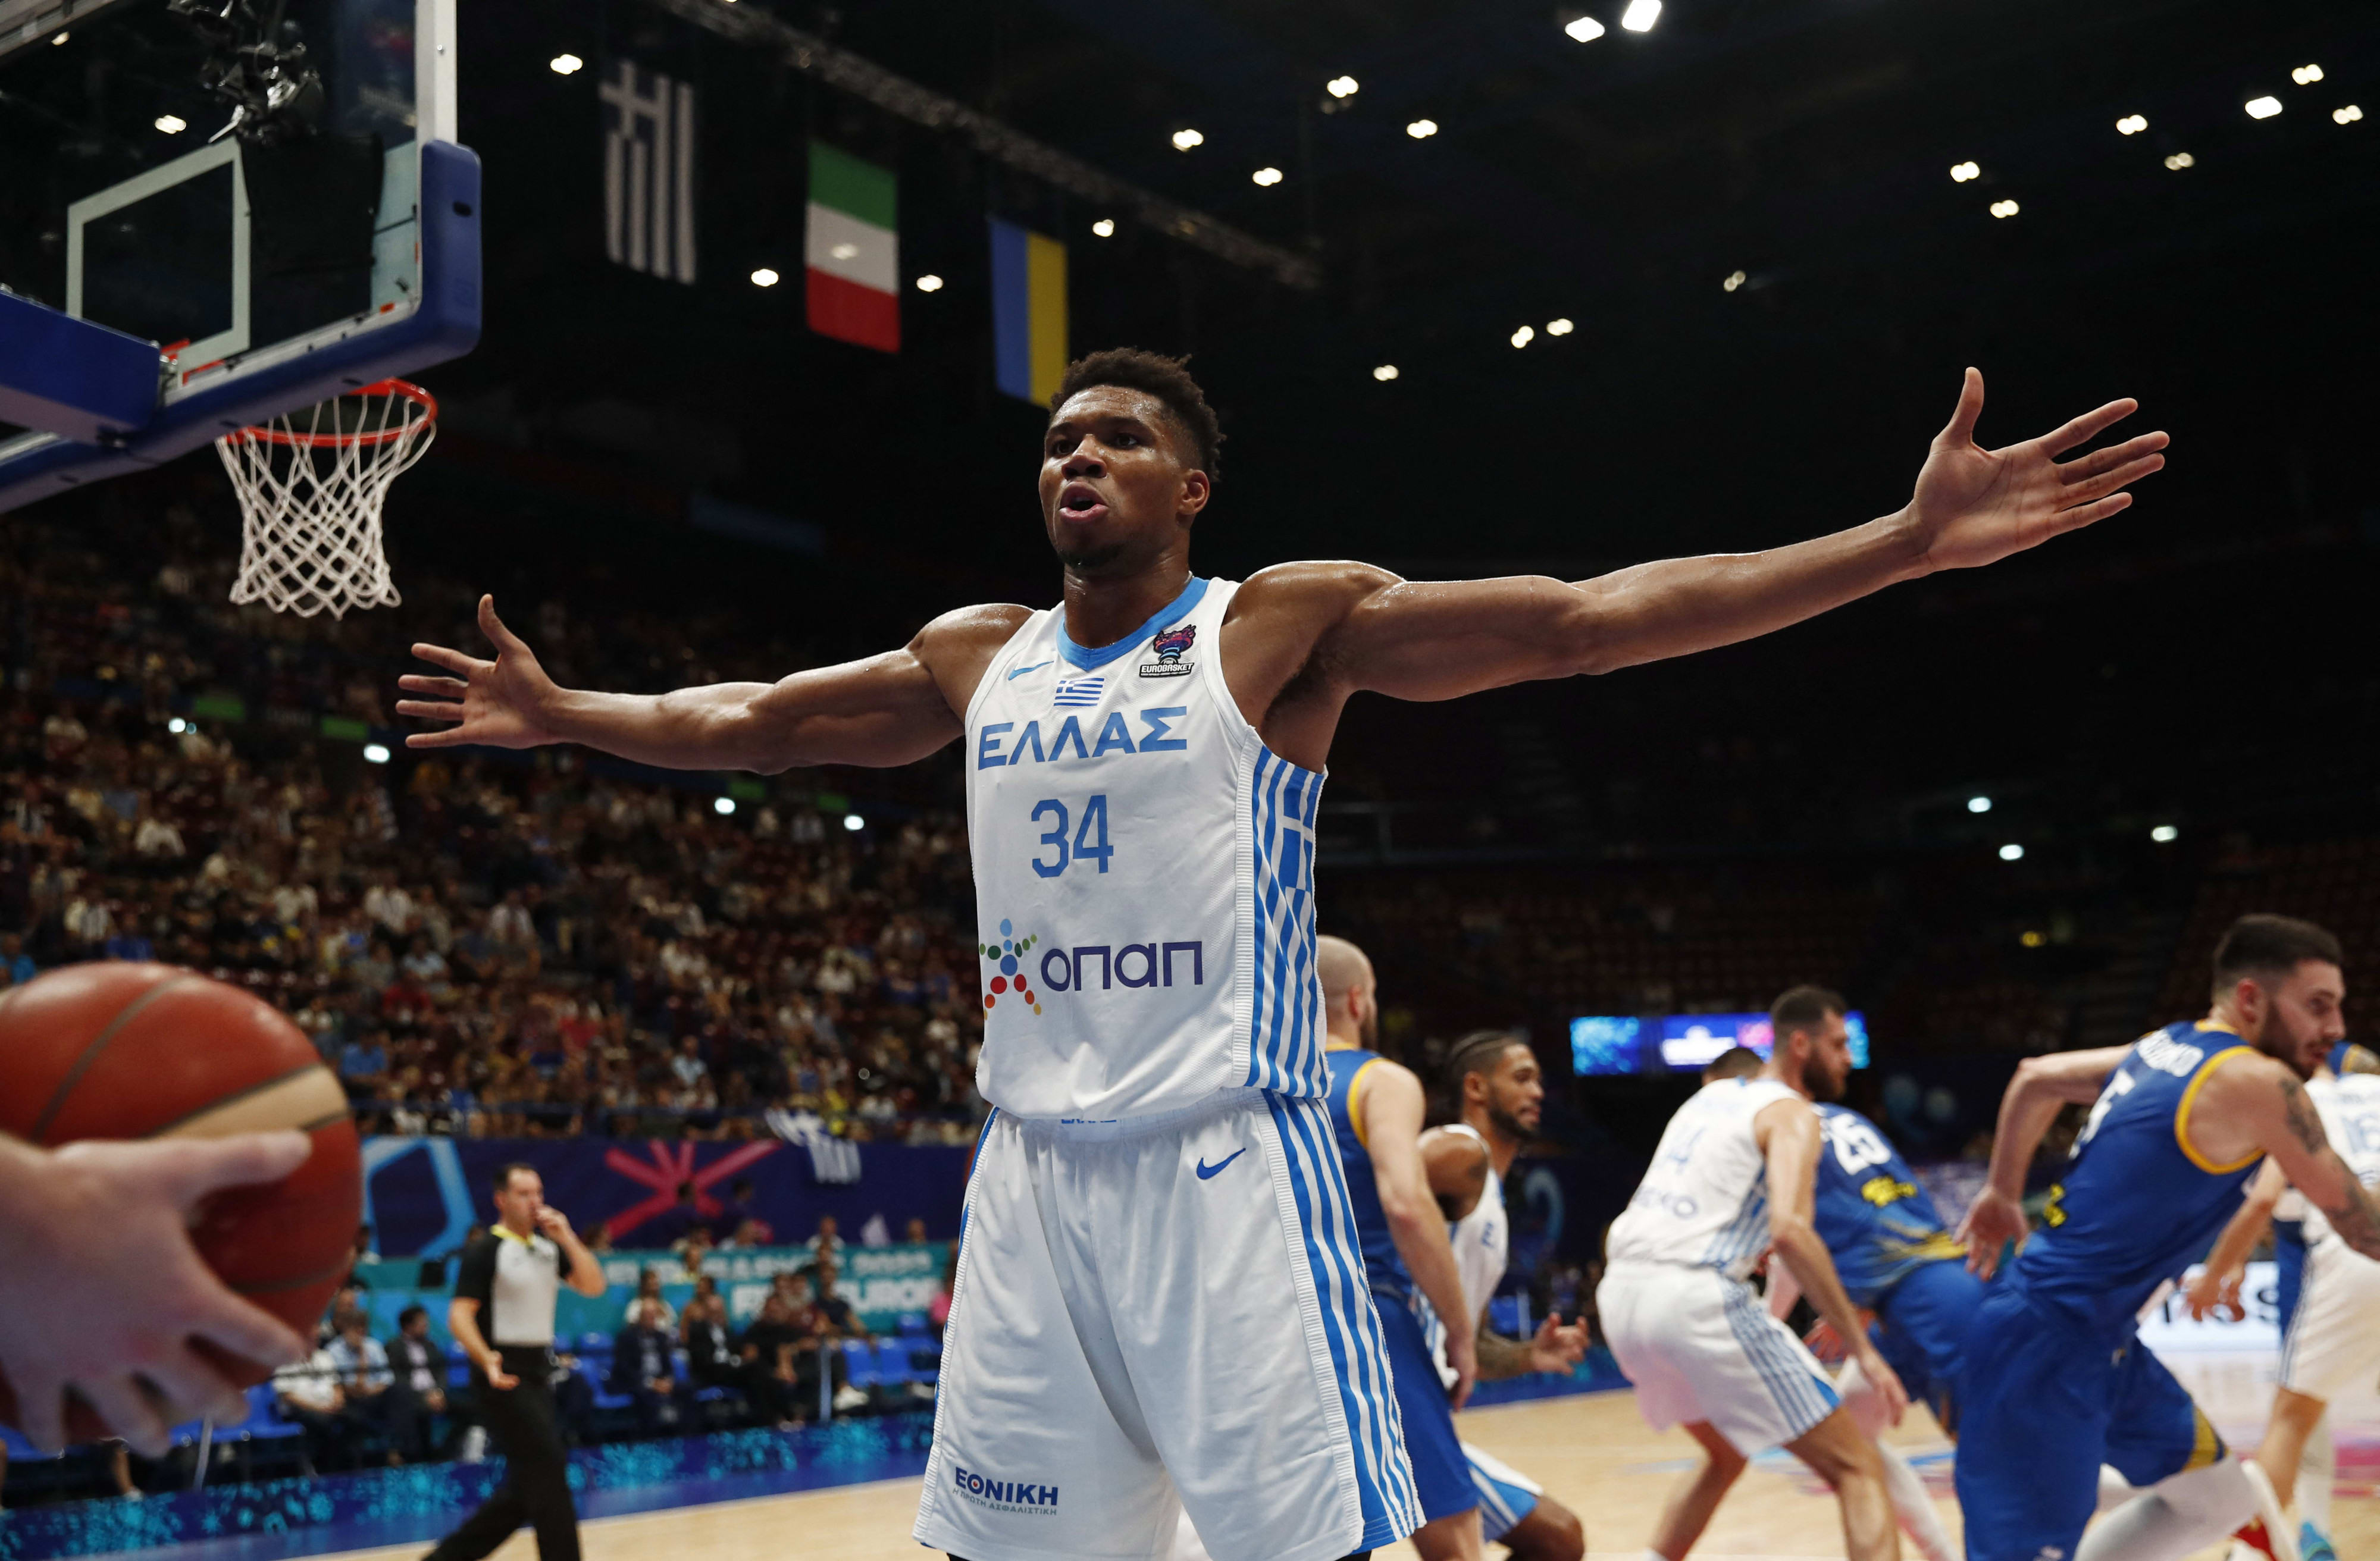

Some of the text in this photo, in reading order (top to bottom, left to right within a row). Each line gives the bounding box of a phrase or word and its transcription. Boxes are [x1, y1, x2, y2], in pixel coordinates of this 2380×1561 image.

[1141, 663, 1194, 673] EUROBASKET
[978, 706, 1188, 770] ΕΛΛΑΣ
[1031, 794, 1114, 878] 34
[955, 1466, 1059, 1506] ΕΘΝΙΚΗ
